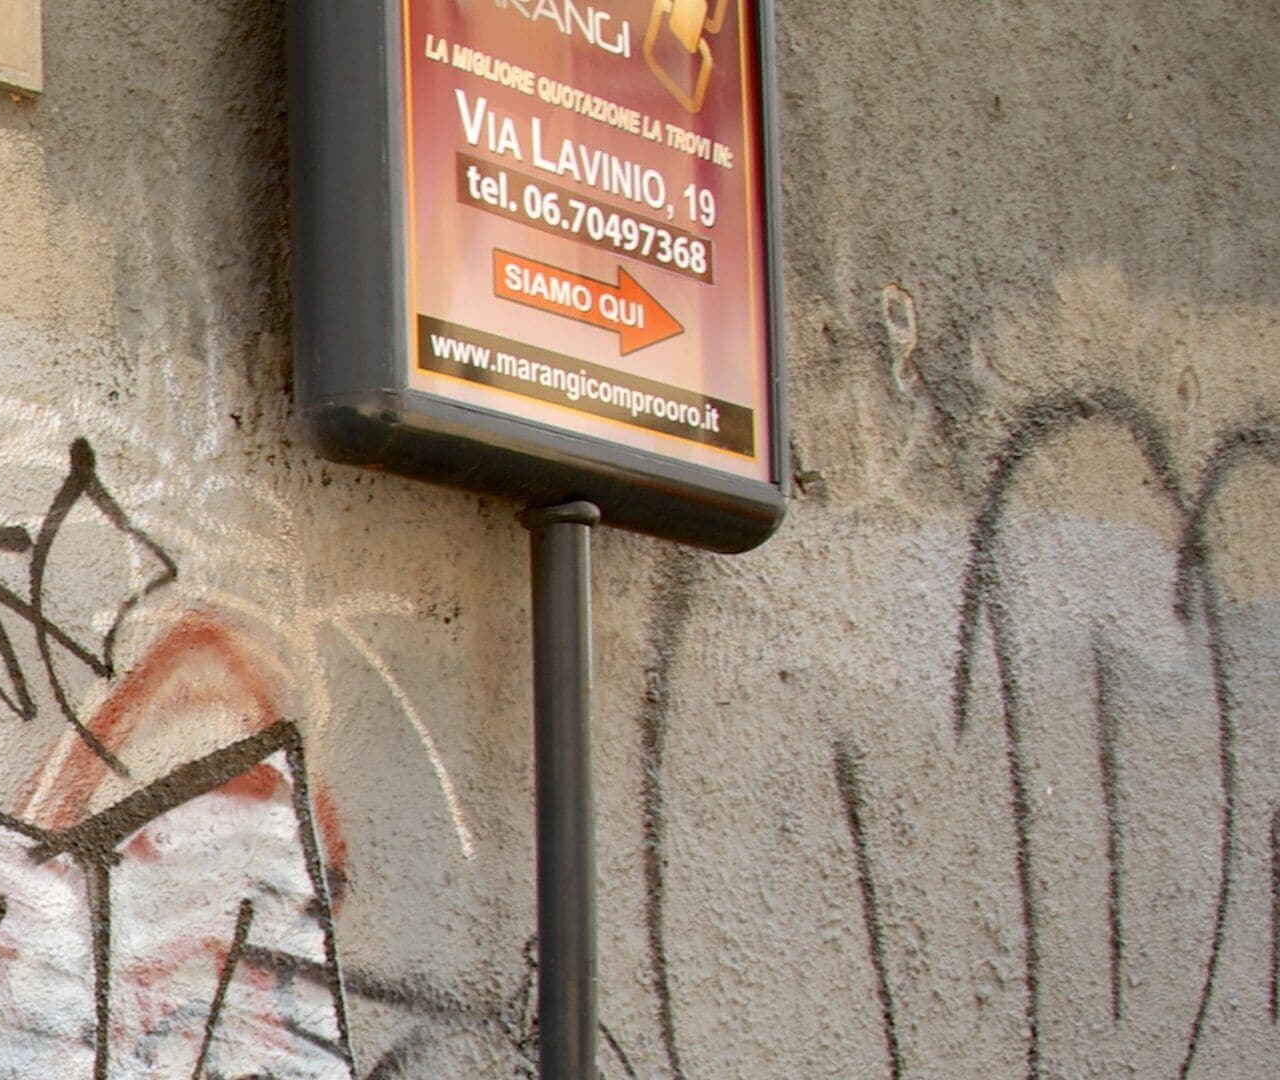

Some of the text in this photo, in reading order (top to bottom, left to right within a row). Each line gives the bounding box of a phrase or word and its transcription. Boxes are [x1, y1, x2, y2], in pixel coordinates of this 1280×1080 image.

[494, 0, 631, 58] ANGI
[425, 34, 734, 170] LA MIGLIORE QUOTAZIONE LA TROVI IN:
[466, 165, 707, 275] tel. 06.70497368
[683, 183, 717, 228] 19
[504, 262, 645, 329] SIAMO QUI
[430, 333, 721, 433] www.marangicomprooro.it
